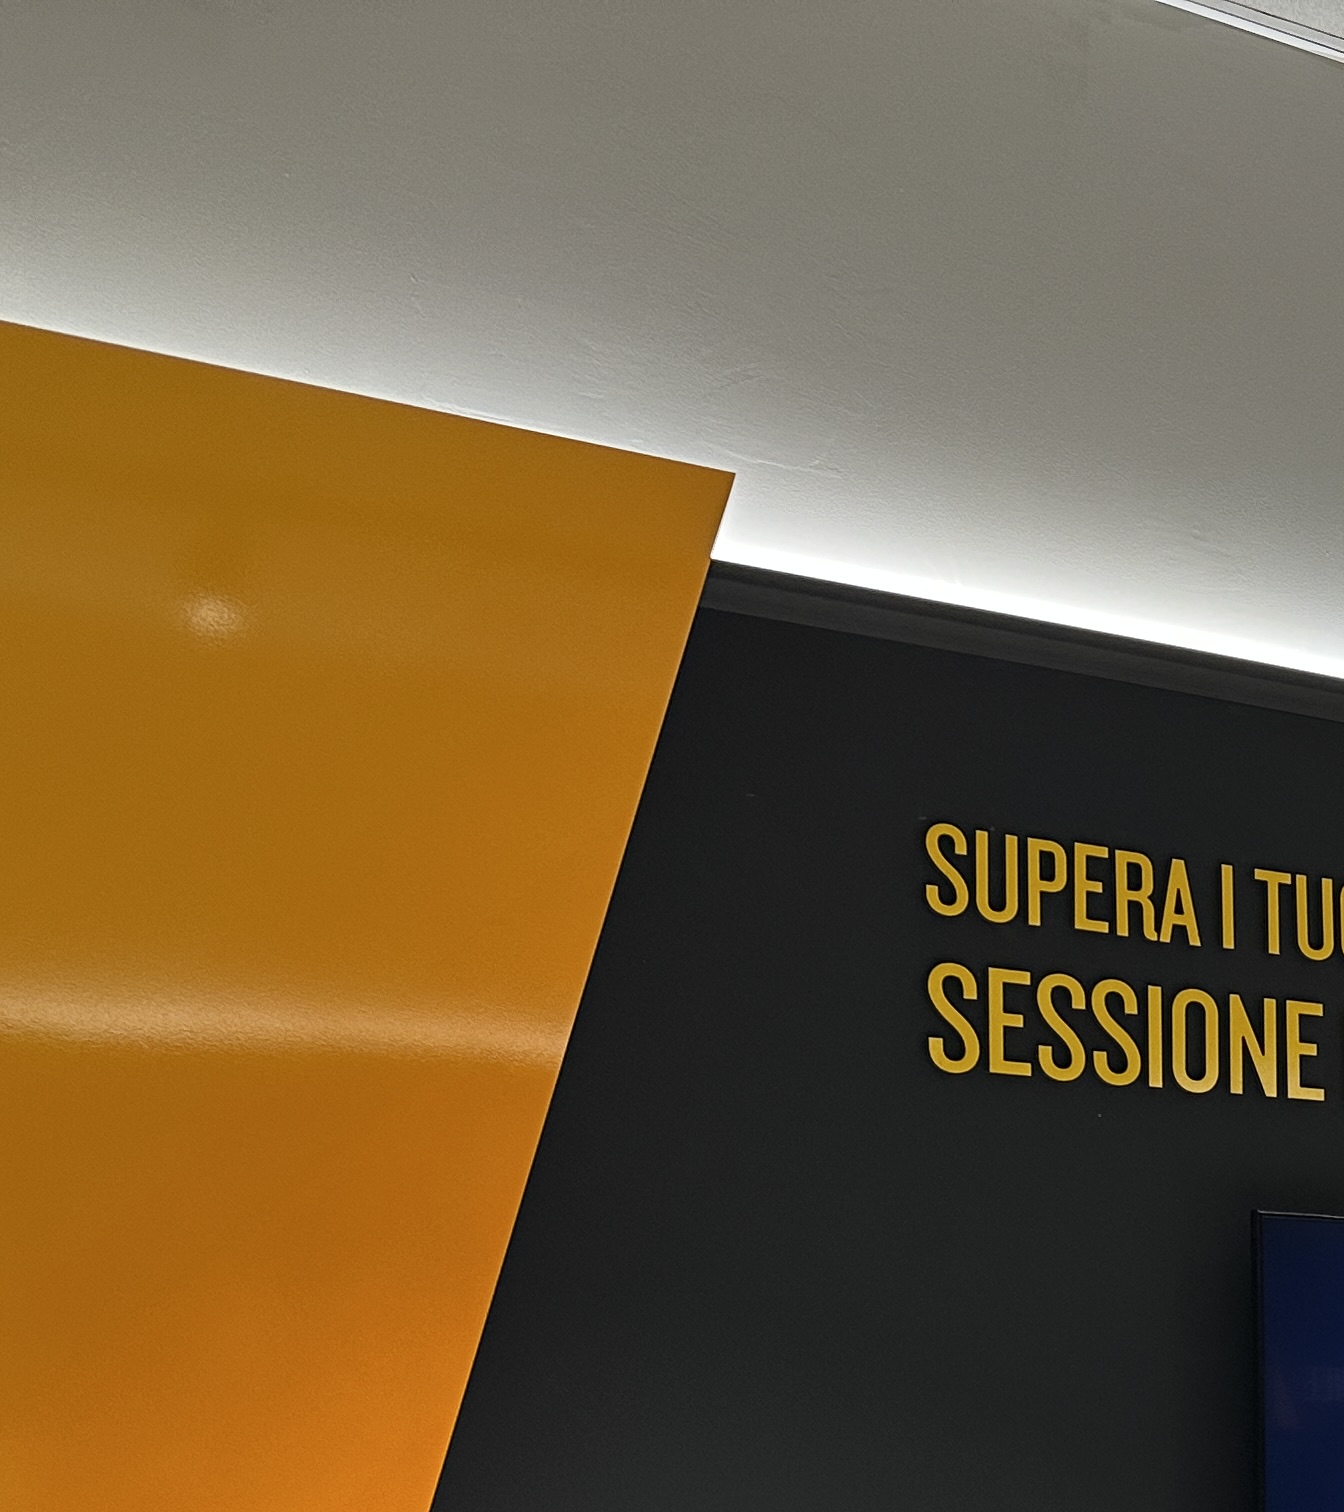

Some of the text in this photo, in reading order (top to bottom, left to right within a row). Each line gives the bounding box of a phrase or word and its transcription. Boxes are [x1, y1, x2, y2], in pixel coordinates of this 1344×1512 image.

[926, 824, 1201, 946] SUPERA
[1221, 864, 1234, 949] I
[928, 963, 1324, 1101] SESSIONE
